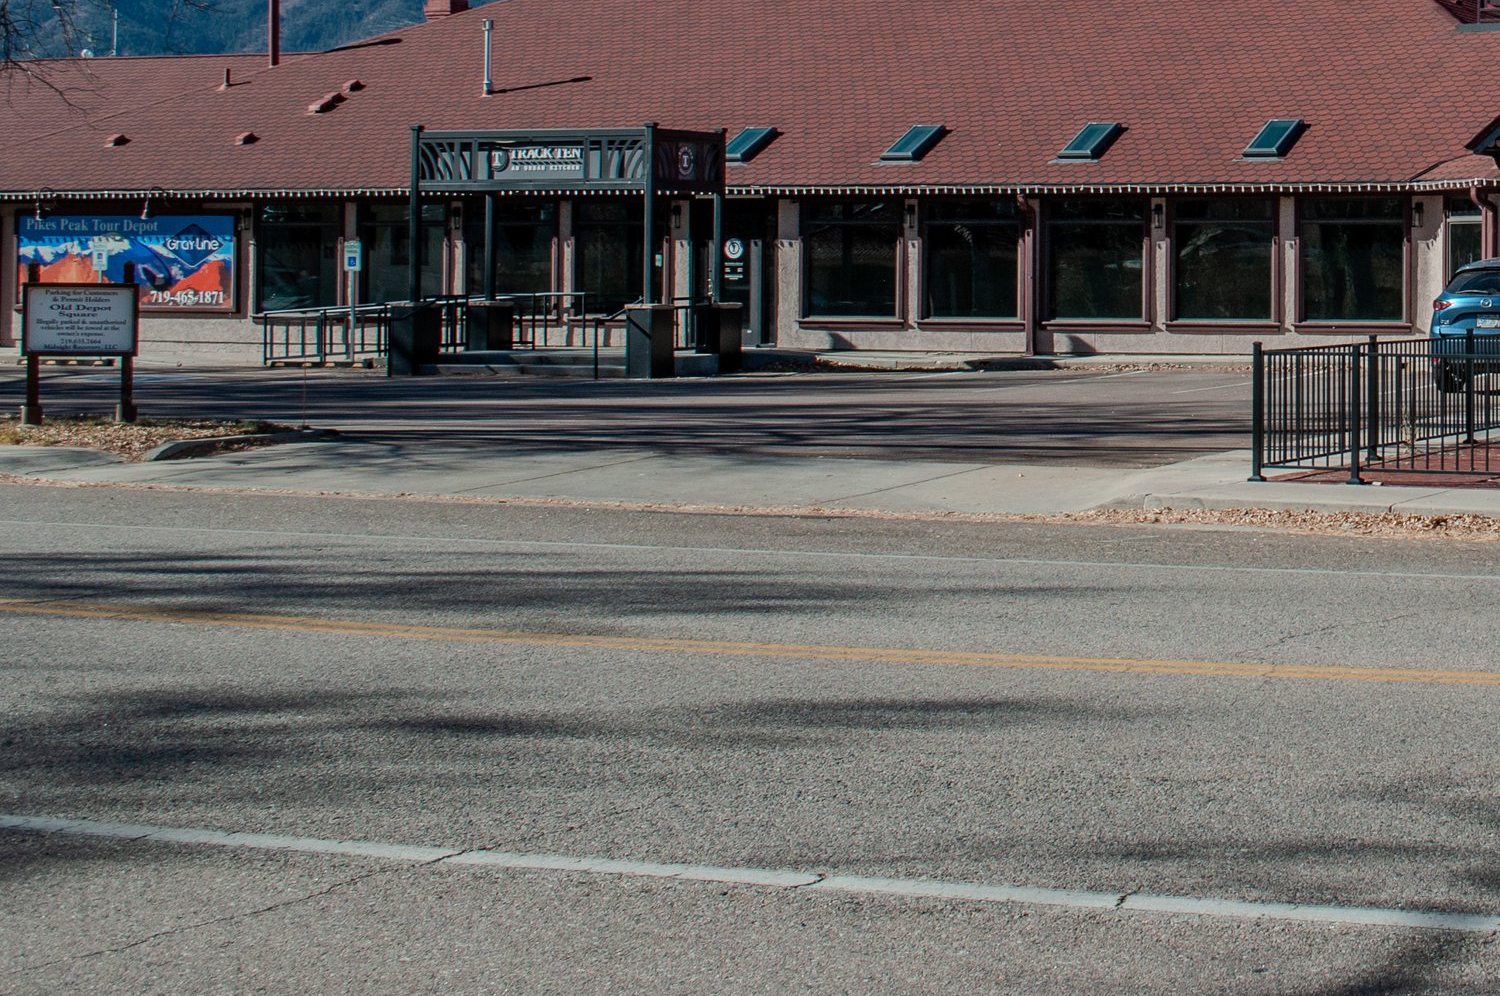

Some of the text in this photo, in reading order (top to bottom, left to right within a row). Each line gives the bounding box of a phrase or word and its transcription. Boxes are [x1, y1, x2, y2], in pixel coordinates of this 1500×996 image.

[511, 148, 581, 159] TRACK TEN
[26, 219, 159, 234] Pikes Peak Tour Depot
[150, 291, 224, 304] 719-465-1871
[76, 304, 112, 312] Depot
